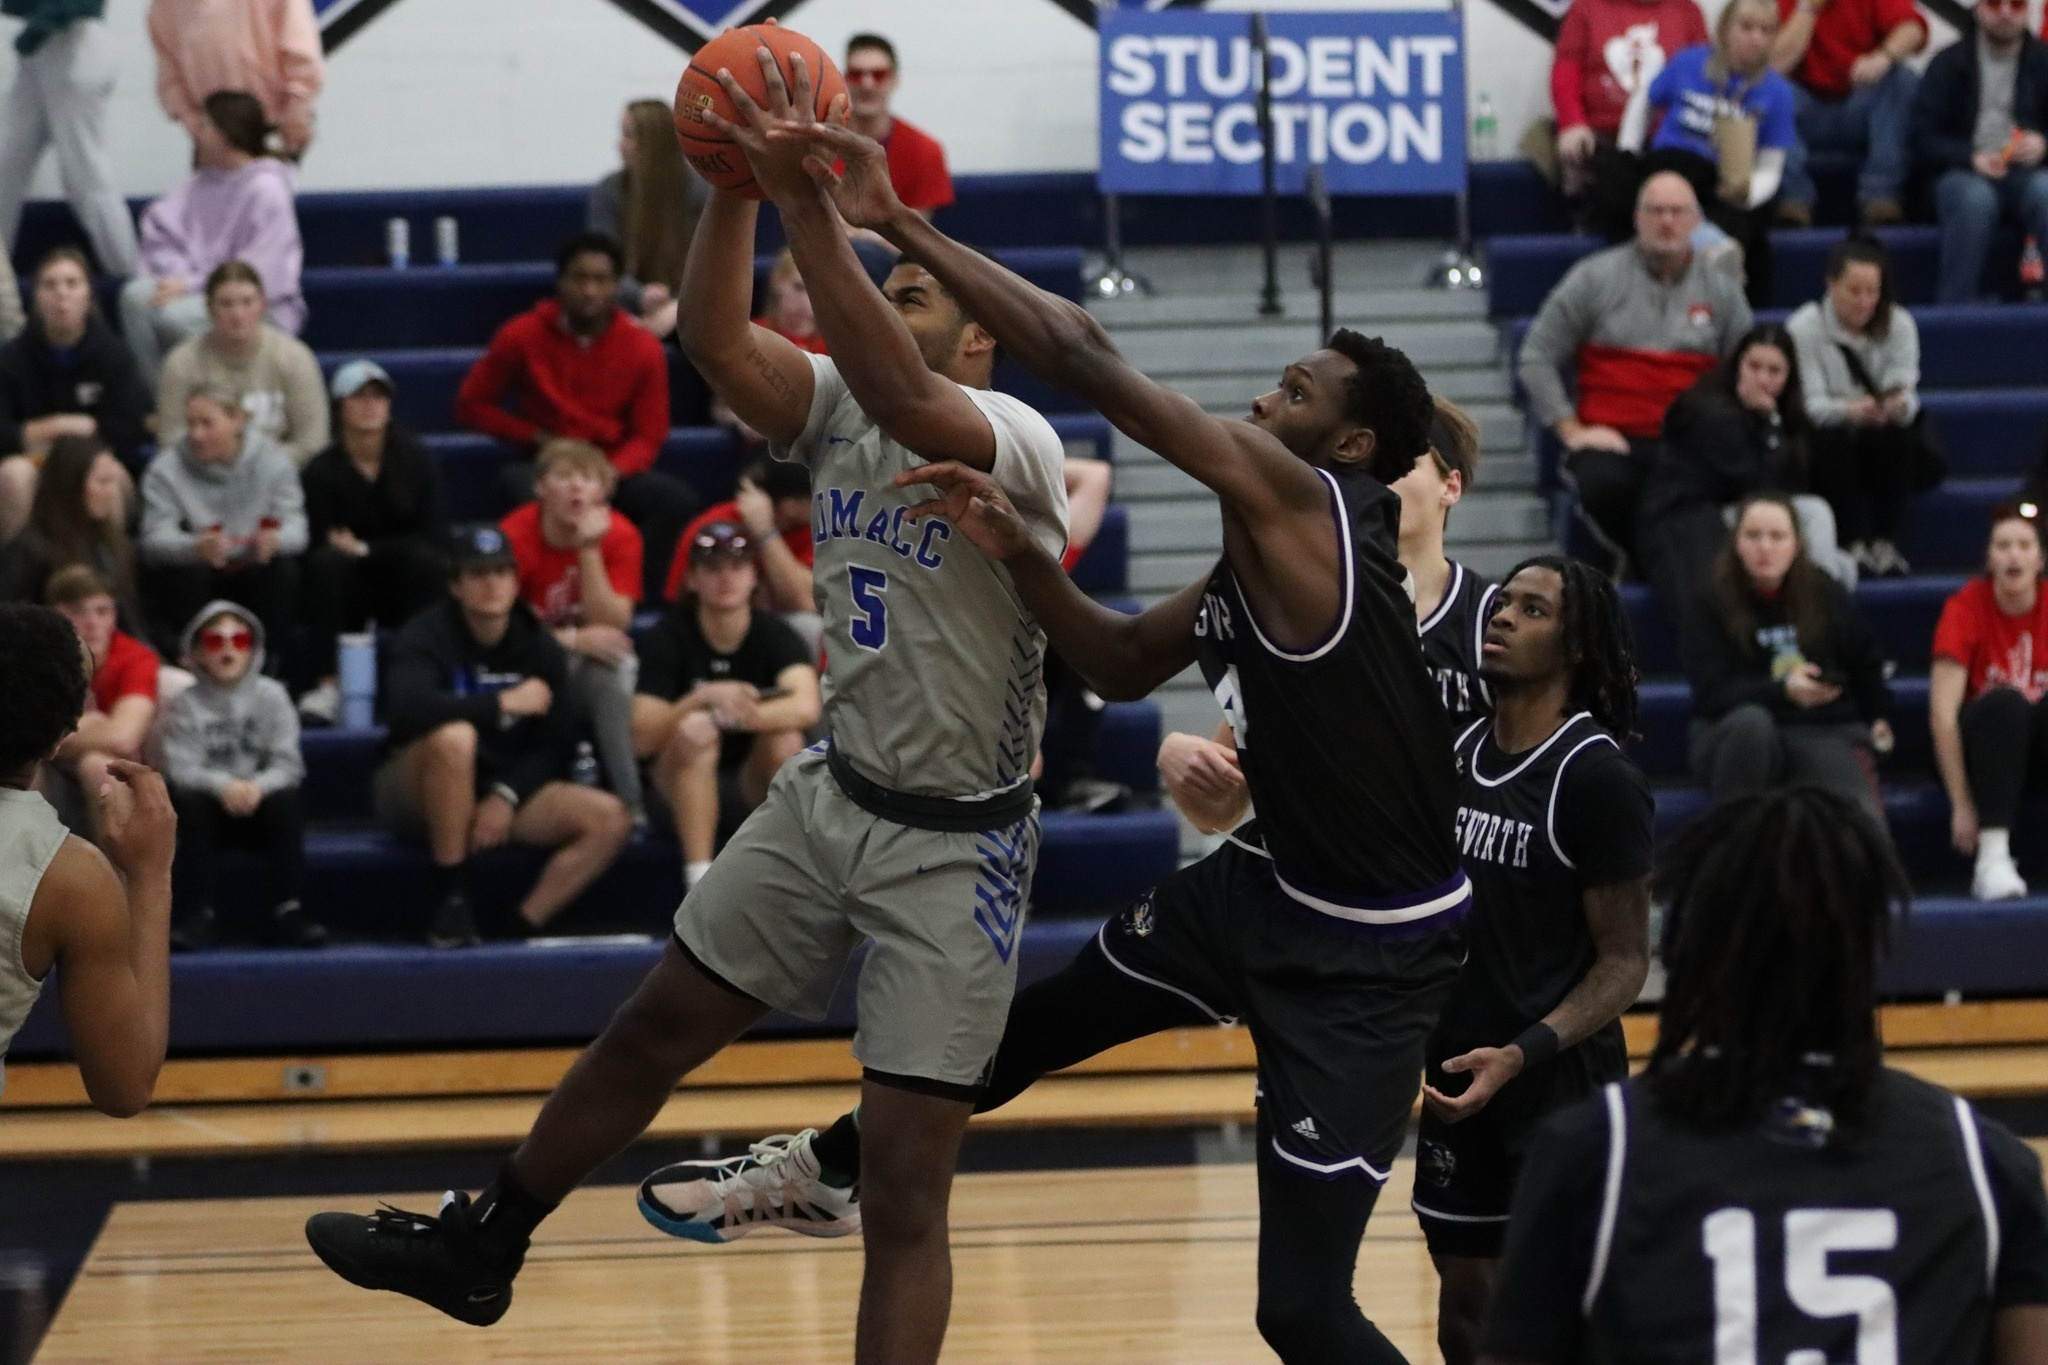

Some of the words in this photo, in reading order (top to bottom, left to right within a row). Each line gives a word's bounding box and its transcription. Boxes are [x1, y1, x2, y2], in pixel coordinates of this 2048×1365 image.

[1107, 34, 1457, 98] STUDENT
[1119, 102, 1443, 164] SECTION
[847, 561, 889, 653] 5
[1703, 1207, 1898, 1365] 15
